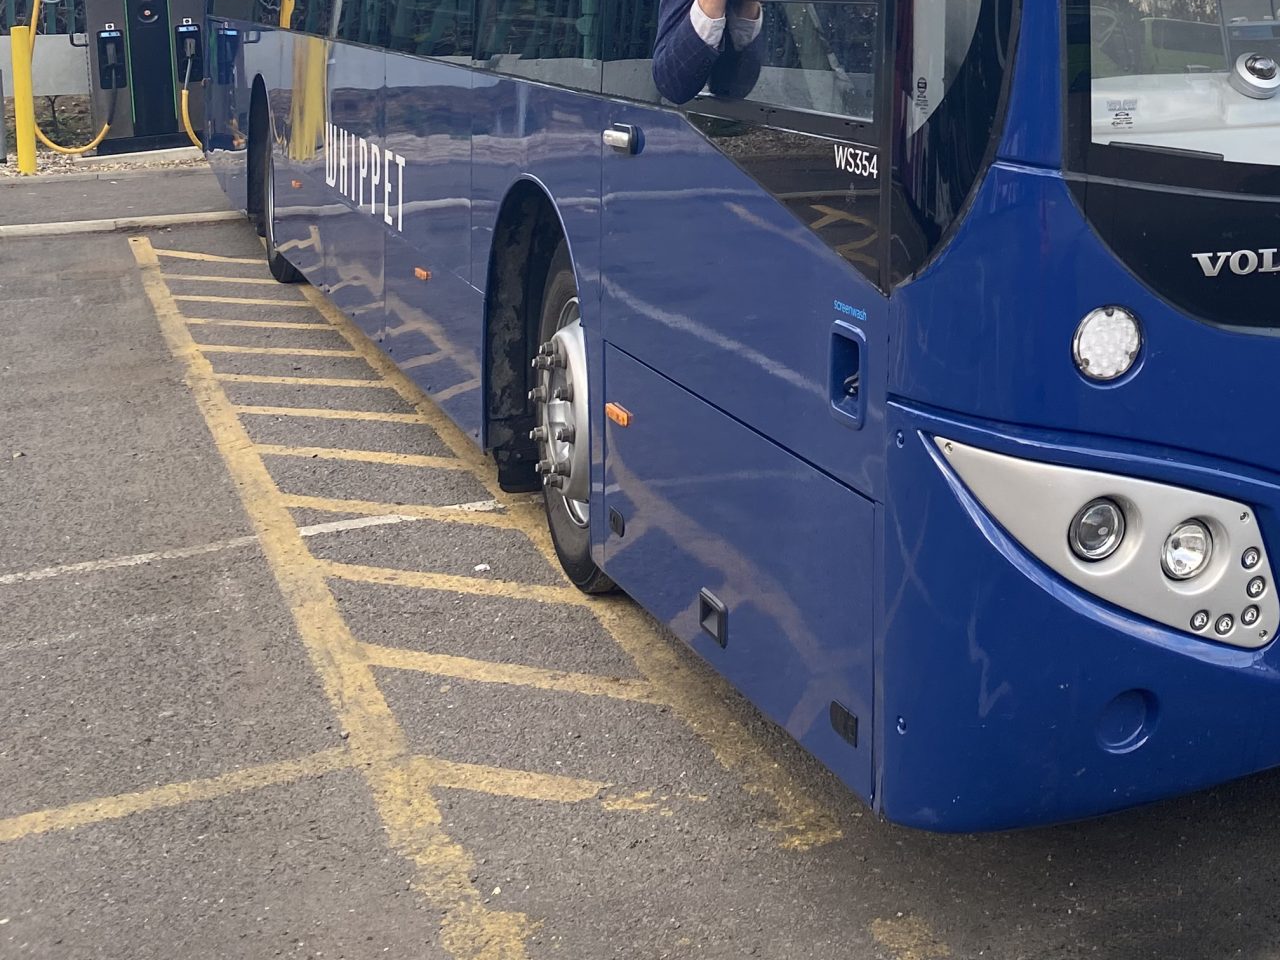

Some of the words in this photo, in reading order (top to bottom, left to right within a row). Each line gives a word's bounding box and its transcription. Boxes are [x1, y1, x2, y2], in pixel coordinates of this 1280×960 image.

[325, 121, 406, 232] WHIPPET
[834, 144, 878, 179] WS354
[833, 299, 867, 321] screenwash
